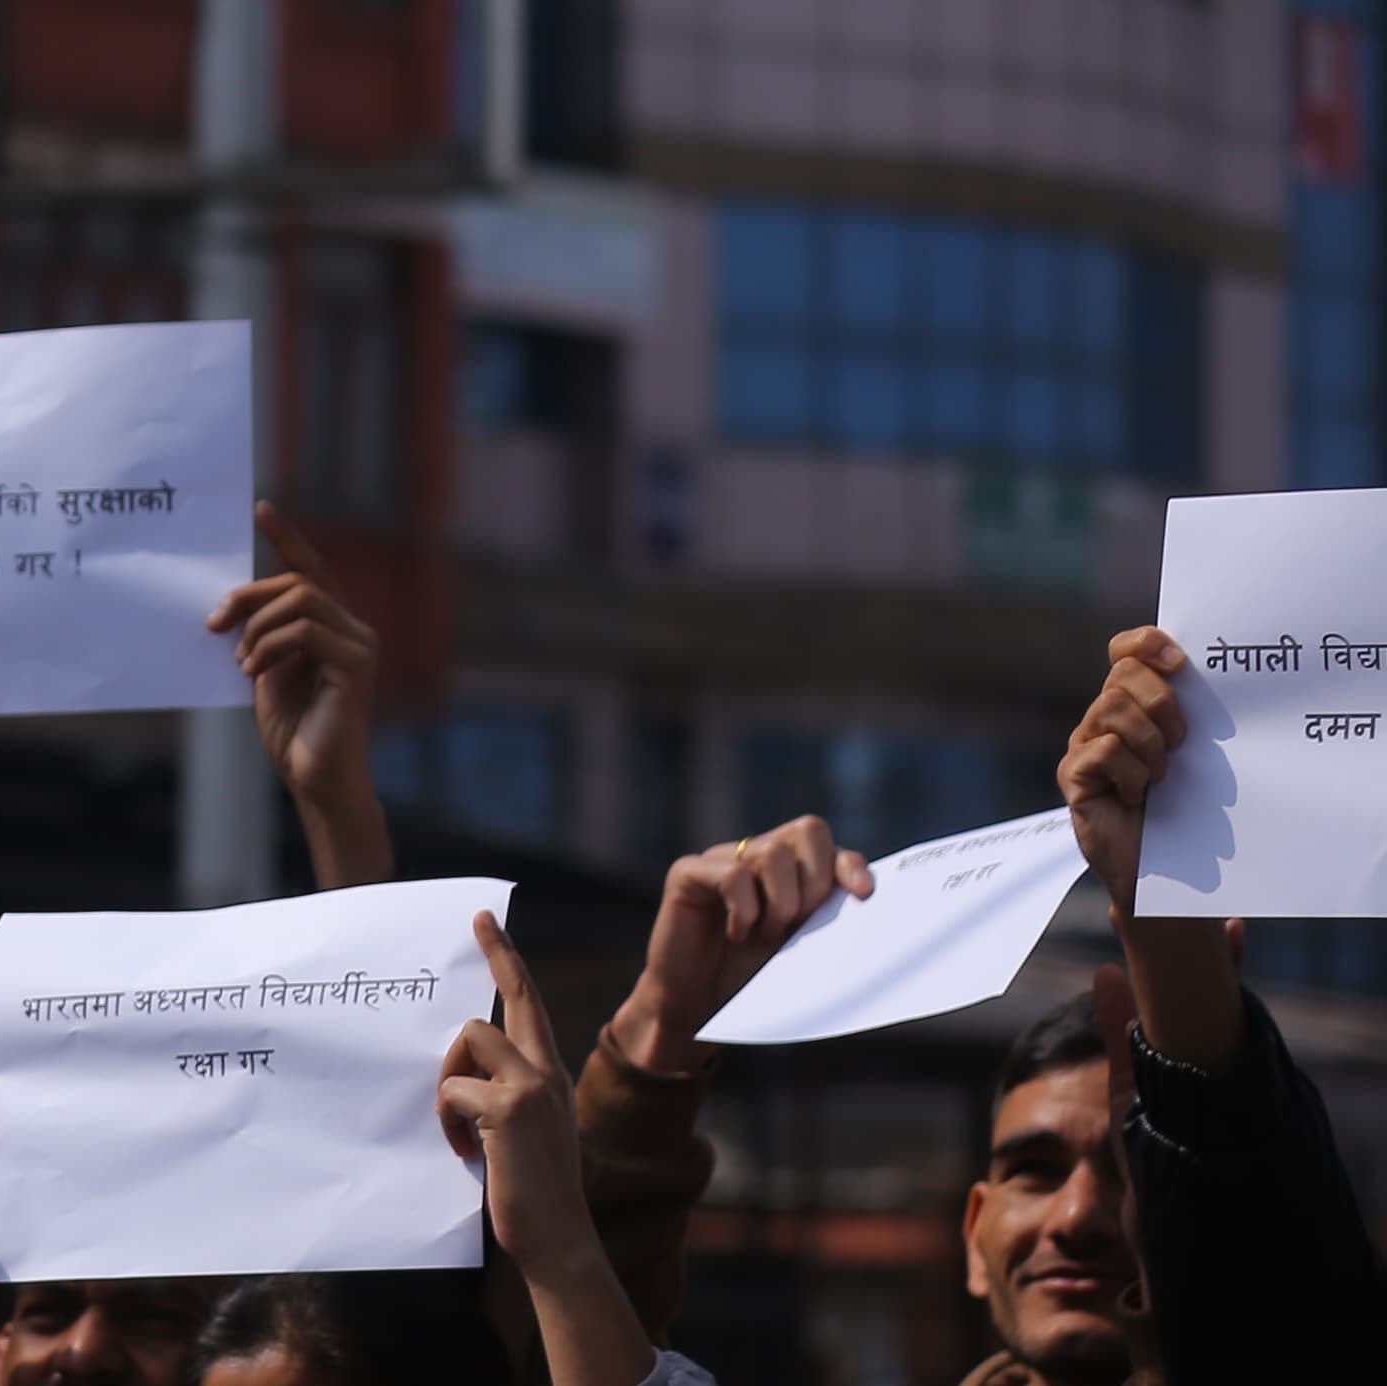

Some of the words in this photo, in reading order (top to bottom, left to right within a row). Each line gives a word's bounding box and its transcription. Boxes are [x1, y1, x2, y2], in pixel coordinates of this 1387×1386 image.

[57, 479, 177, 526] सुरक्षाको
[14, 552, 56, 577] गर
[72, 547, 84, 578] !
[1206, 634, 1304, 673] नेपाली
[1318, 633, 1387, 672] विद्य
[1304, 713, 1382, 743] दमन
[22, 991, 126, 1022] भारतमा
[133, 984, 252, 1015] अध्यनरत
[175, 1051, 230, 1078] रक्षा
[236, 1049, 275, 1075] गर
